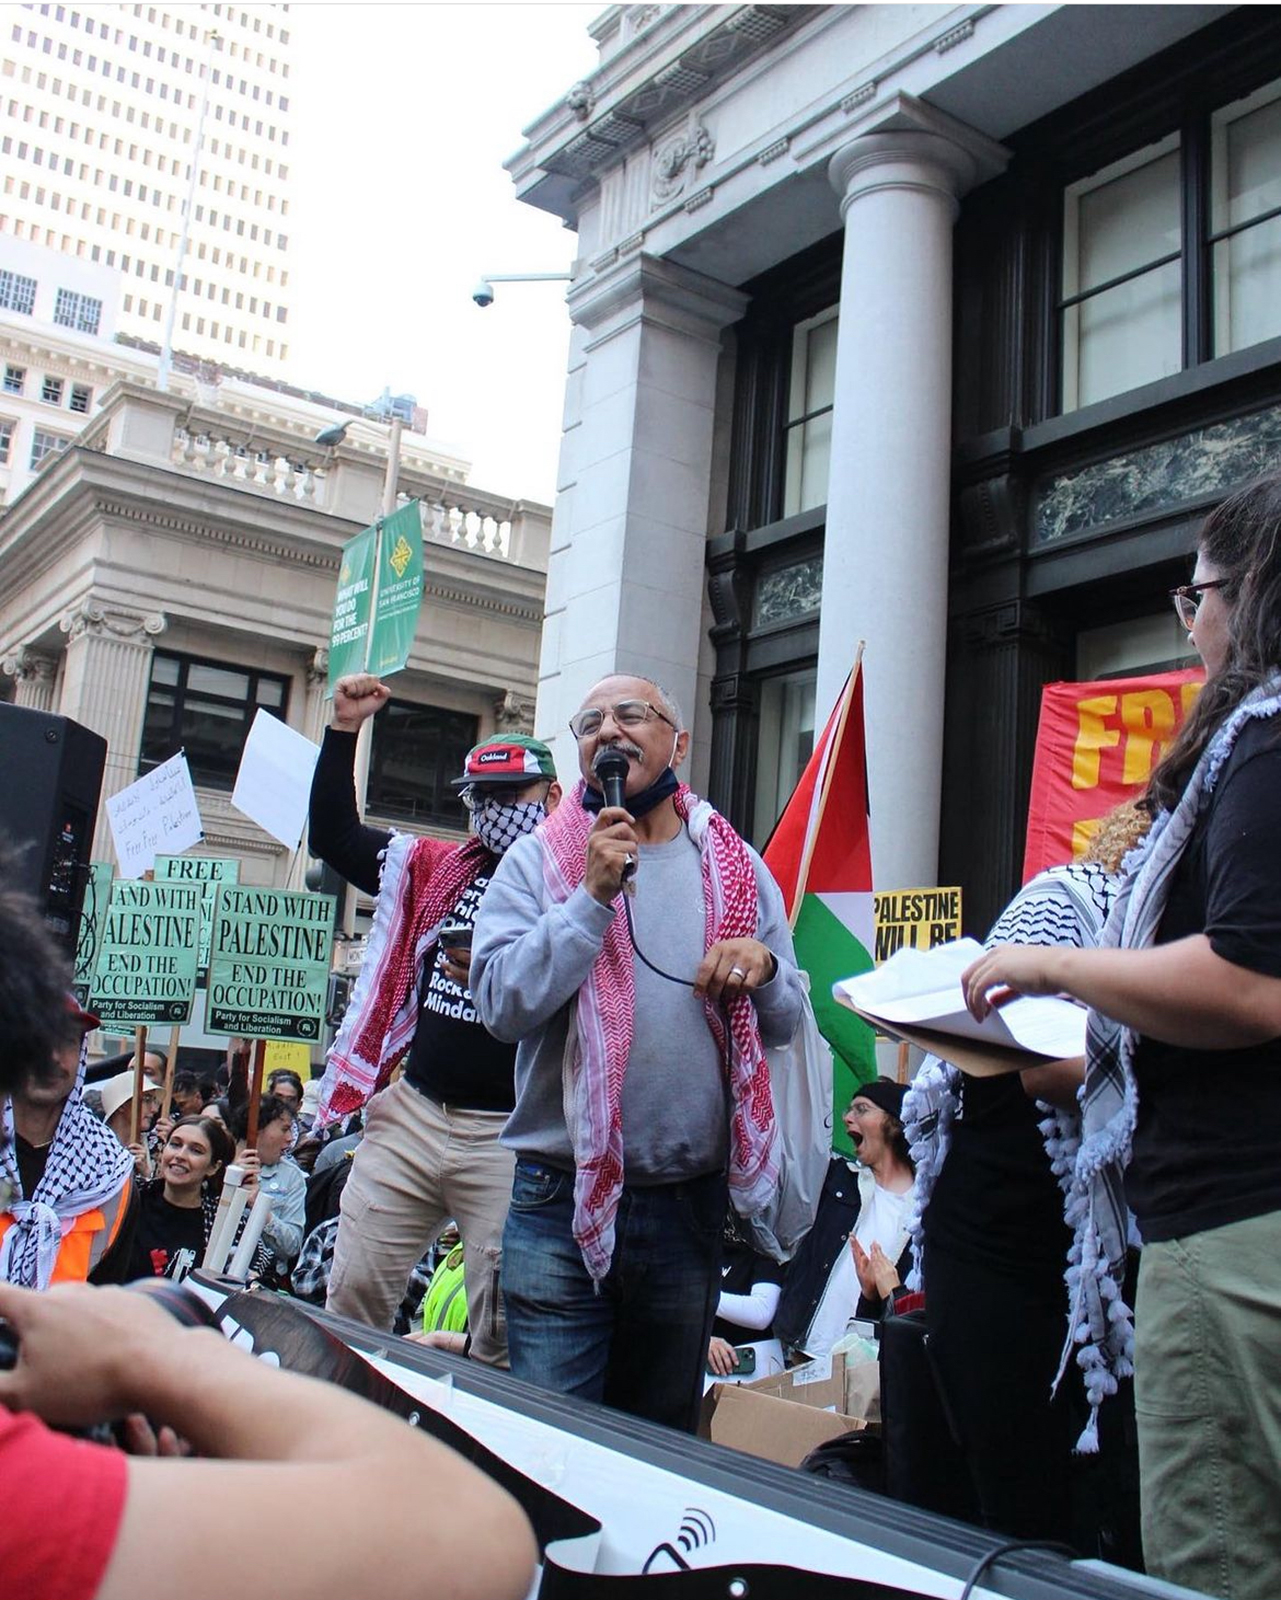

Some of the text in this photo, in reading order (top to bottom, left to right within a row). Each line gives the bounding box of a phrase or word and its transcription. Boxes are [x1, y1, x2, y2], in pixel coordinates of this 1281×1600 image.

[380, 579, 411, 598] UNIVERSITY
[1071, 682, 1204, 790] FR
[480, 752, 508, 763] Oakland
[167, 859, 222, 881] FREE
[109, 885, 151, 907] AND
[154, 887, 196, 911] WITH
[222, 889, 279, 917] STAND
[283, 896, 330, 922] WITH
[103, 913, 194, 949] ALESTINE
[218, 919, 328, 962] PALESTINE
[108, 953, 141, 973] END
[146, 955, 178, 975] THE
[91, 974, 191, 998] OCCUPATION!
[232, 963, 307, 989] END THE
[93, 1000, 114, 1011] Party
[114, 1000, 126, 1010] for
[127, 1001, 165, 1012] Socialism
[213, 984, 322, 1014] OCCUPATION!
[101, 1011, 156, 1020] and Liberation
[215, 1010, 292, 1026] Party for Socialism
[223, 1021, 282, 1035] and Liberation
